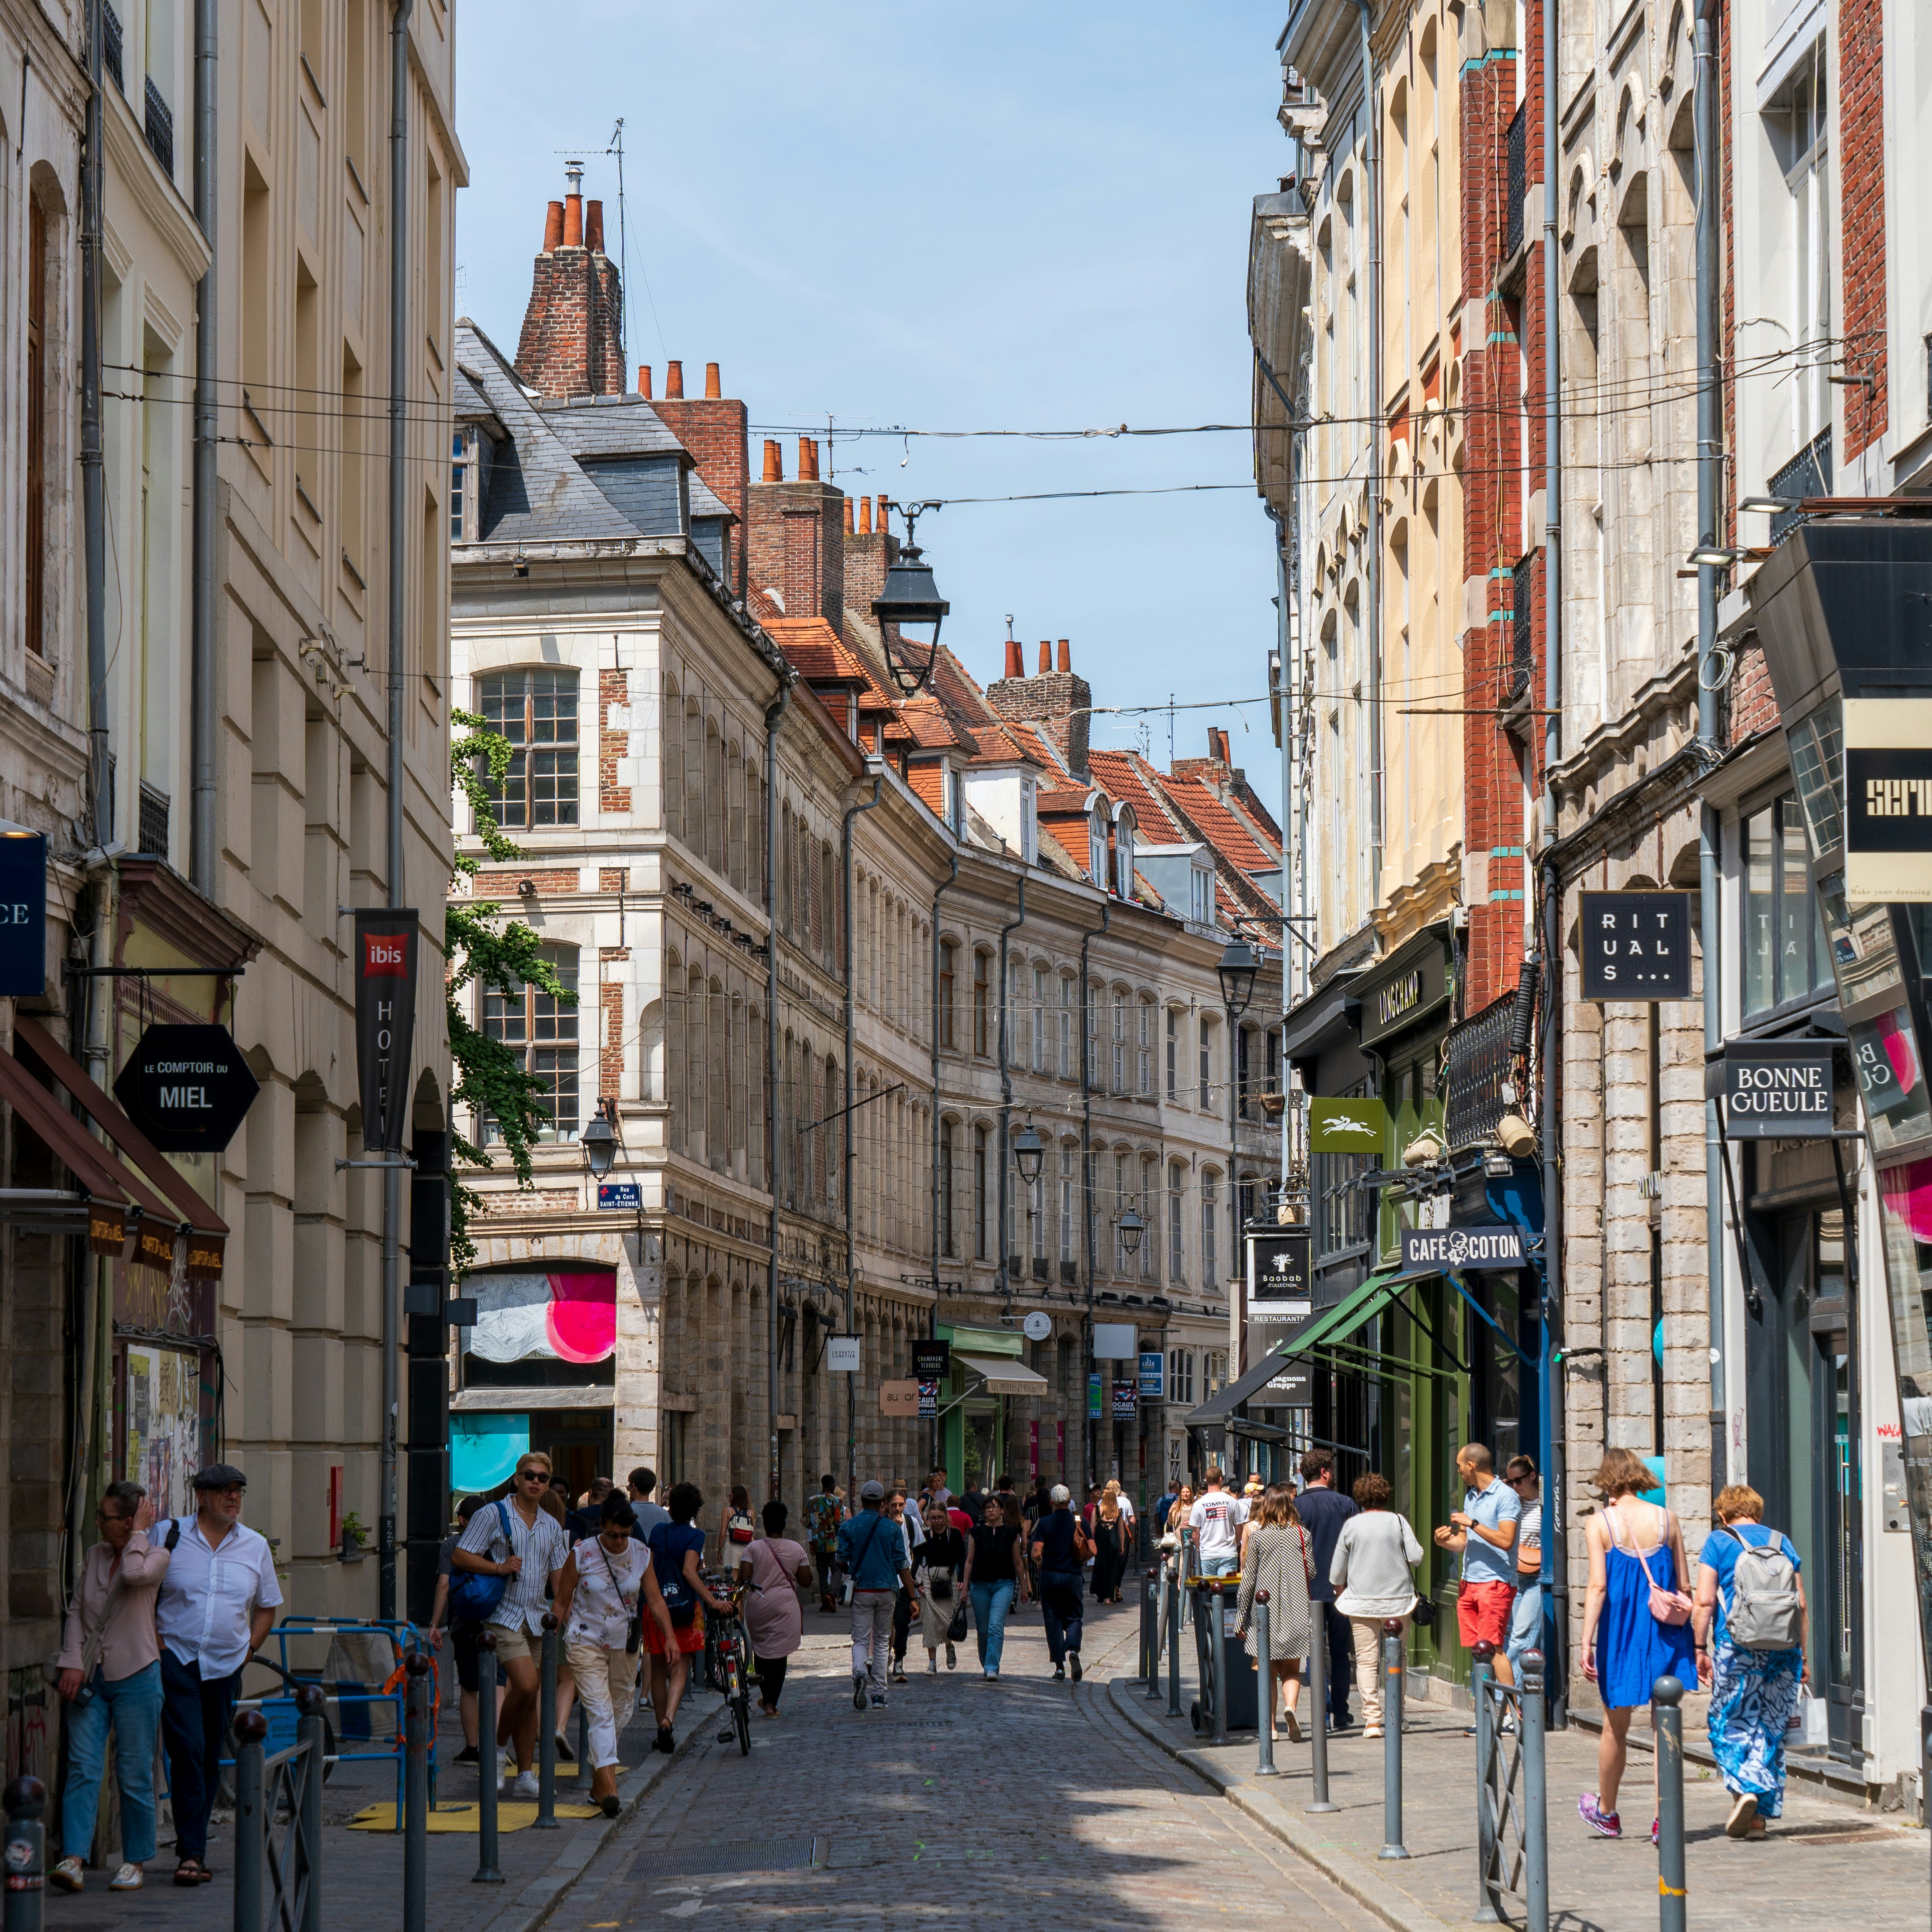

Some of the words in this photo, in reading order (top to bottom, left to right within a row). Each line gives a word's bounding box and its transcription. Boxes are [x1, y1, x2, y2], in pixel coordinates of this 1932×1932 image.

[371, 946, 401, 963] ibis
[1379, 970, 1418, 1025] LONGCHAMP
[158, 1062, 213, 1073] COMPTOIR
[1738, 1068, 1822, 1088] BONNE
[160, 1087, 212, 1108] MIEL
[1731, 1091, 1828, 1112] GUEULE
[1409, 1235, 1447, 1261] CAFÉ
[1469, 1235, 1520, 1259] COTON
